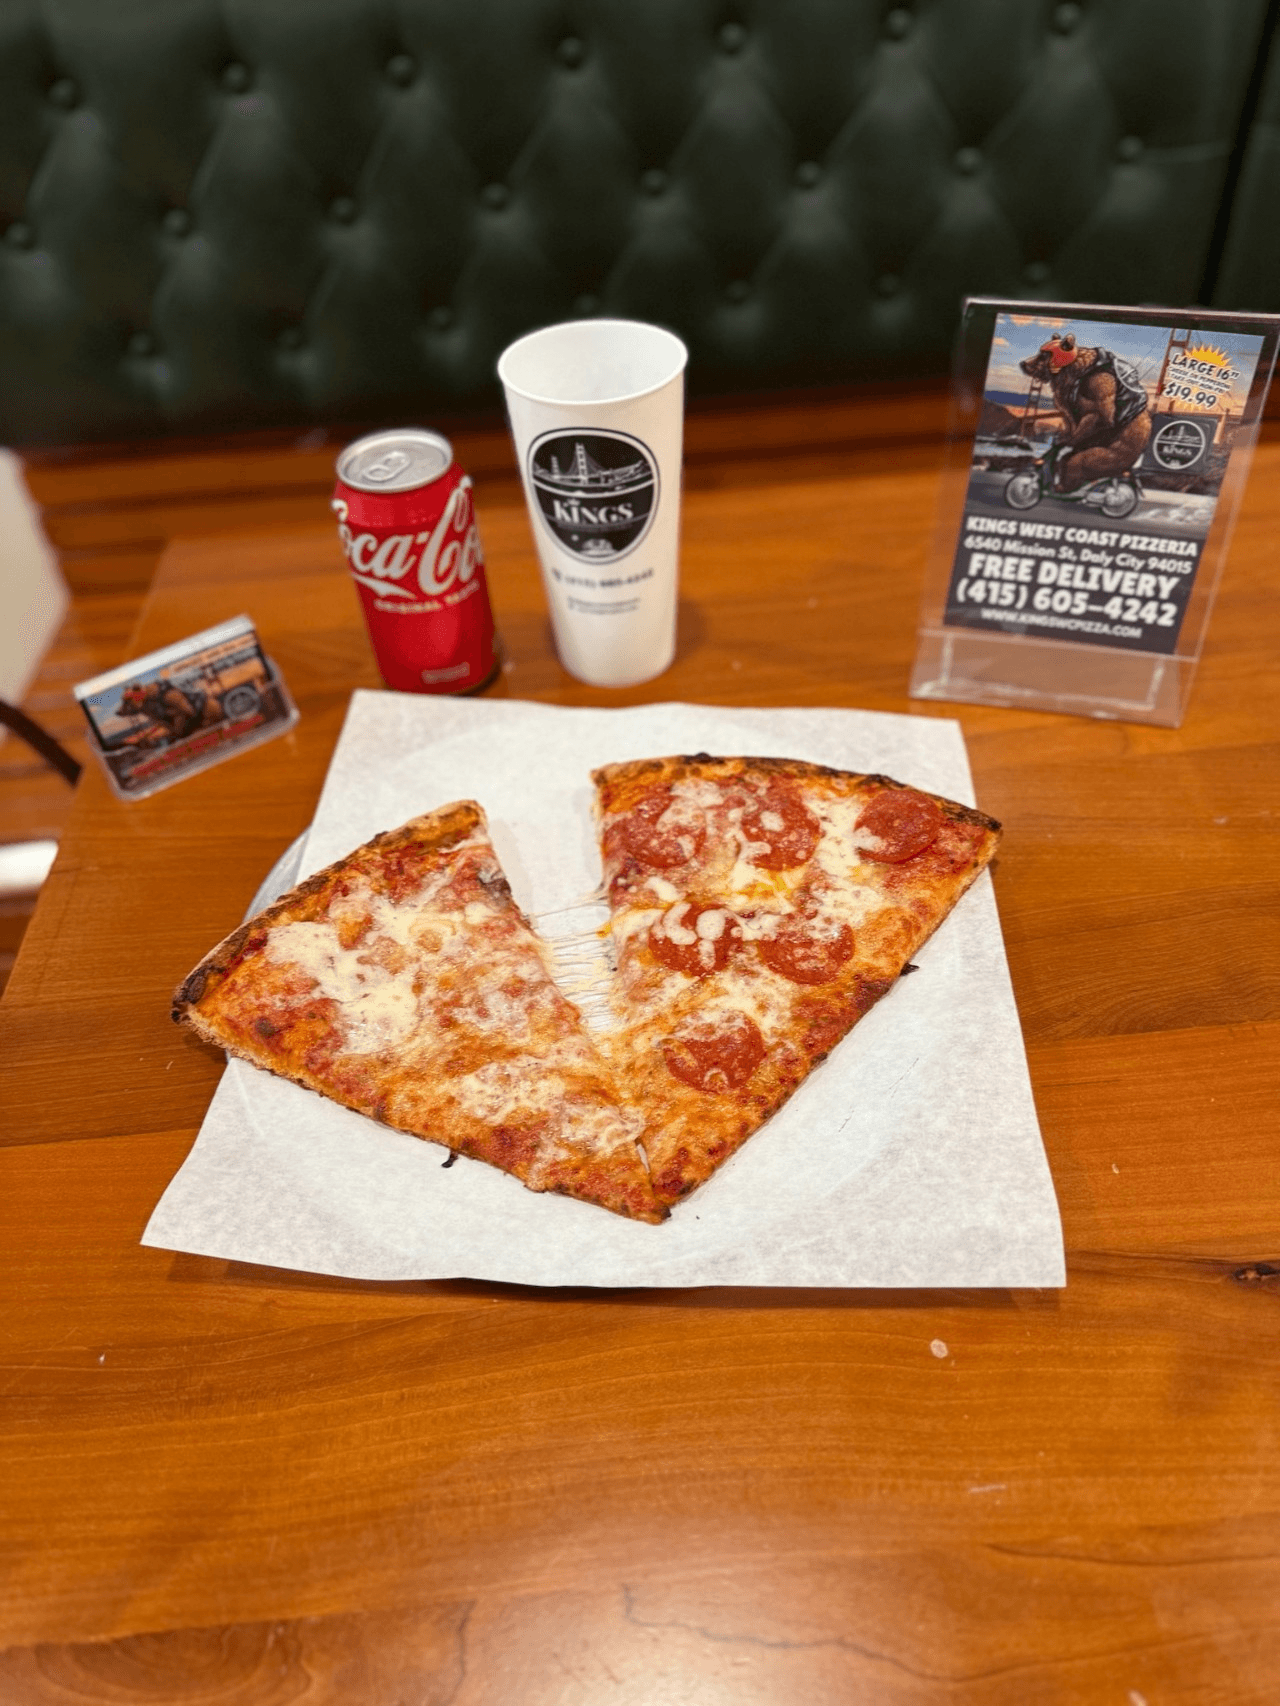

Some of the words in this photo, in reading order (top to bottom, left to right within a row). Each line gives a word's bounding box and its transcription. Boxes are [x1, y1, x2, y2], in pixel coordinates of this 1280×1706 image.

[1171, 353, 1216, 376] LARGE
[1165, 381, 1217, 408] $19.99
[553, 499, 634, 525] KINGS
[964, 535, 1001, 552] 6540
[1003, 539, 1056, 558] Mission
[1080, 548, 1114, 568] Daly
[1115, 553, 1146, 571] City
[1147, 557, 1193, 575] 94015
[966, 516, 1018, 536] KINGS
[1019, 521, 1065, 541] WEST
[1065, 528, 1120, 549] COAST
[1119, 533, 1199, 558] PIZZERIA
[968, 552, 1036, 583] FREE
[1036, 560, 1181, 600] DELIVERY
[956, 577, 1028, 610] (415)
[1033, 587, 1178, 627] 605-4242
